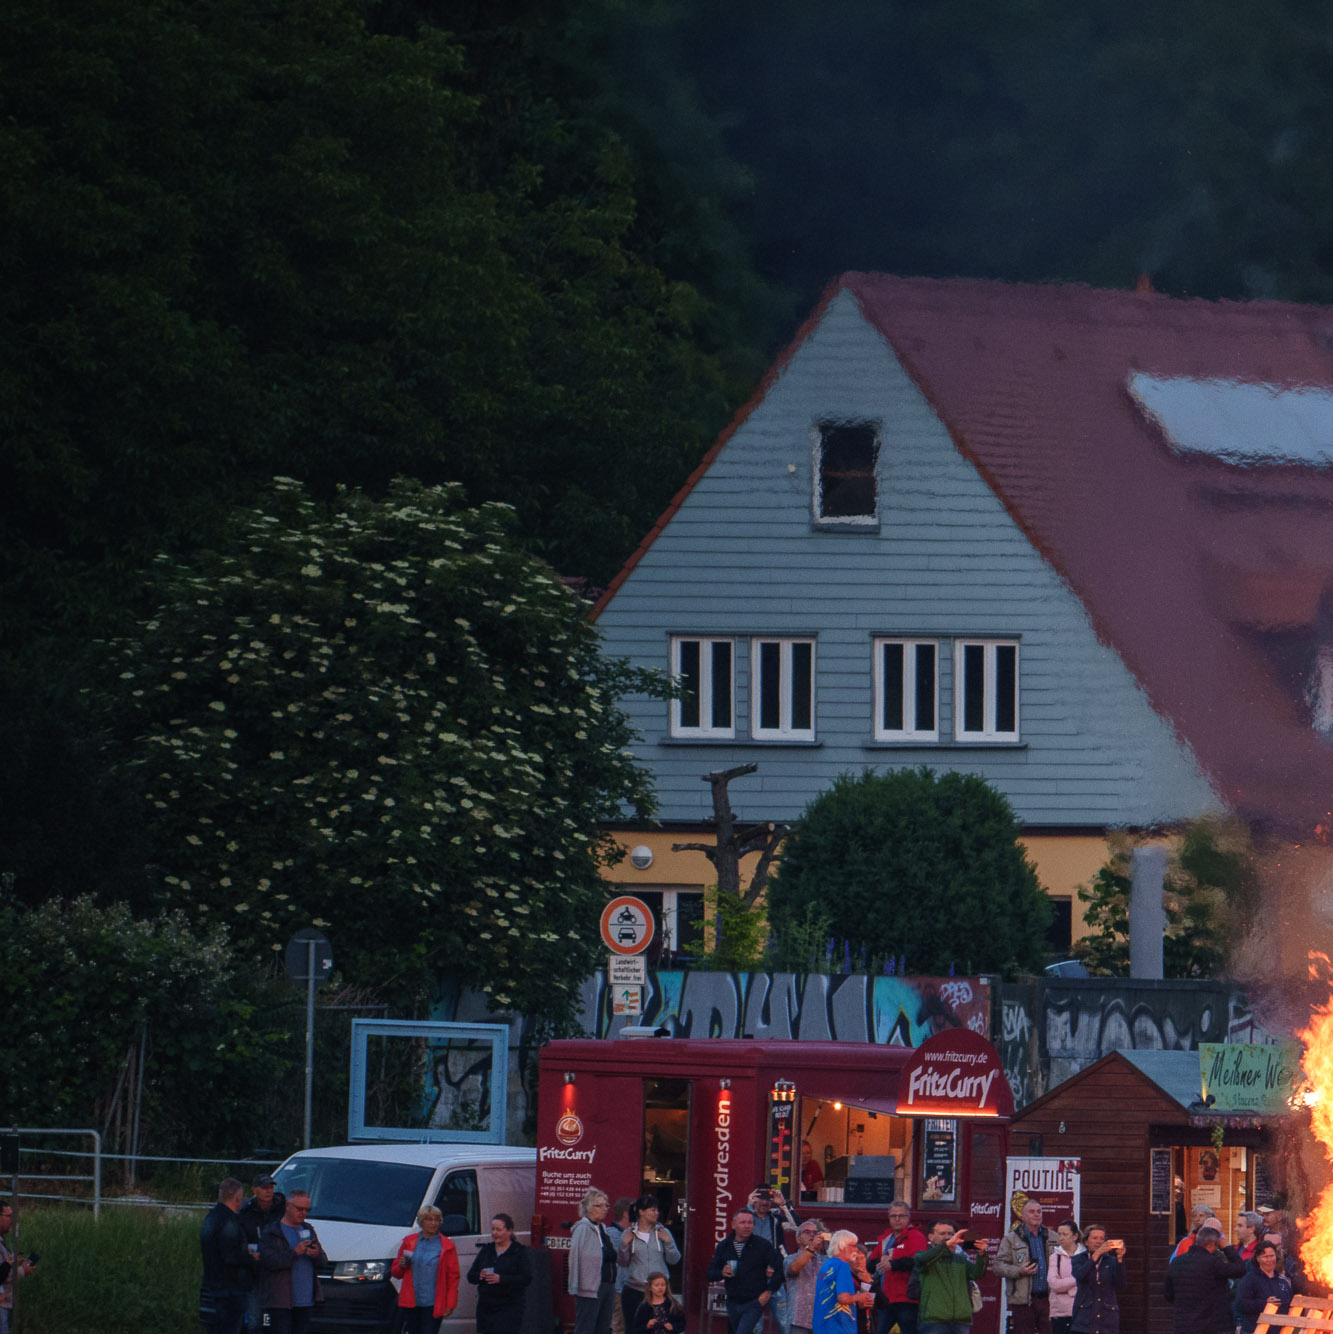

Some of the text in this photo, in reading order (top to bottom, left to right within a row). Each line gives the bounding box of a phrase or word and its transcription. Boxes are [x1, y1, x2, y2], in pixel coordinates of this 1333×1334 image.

[924, 1050, 988, 1067] www.fritzcurry.de
[1208, 1049, 1261, 1089] Meißner
[539, 1146, 596, 1164] FritzCurry
[542, 1170, 561, 1178] Buche
[1012, 1169, 1074, 1190] POUTINE
